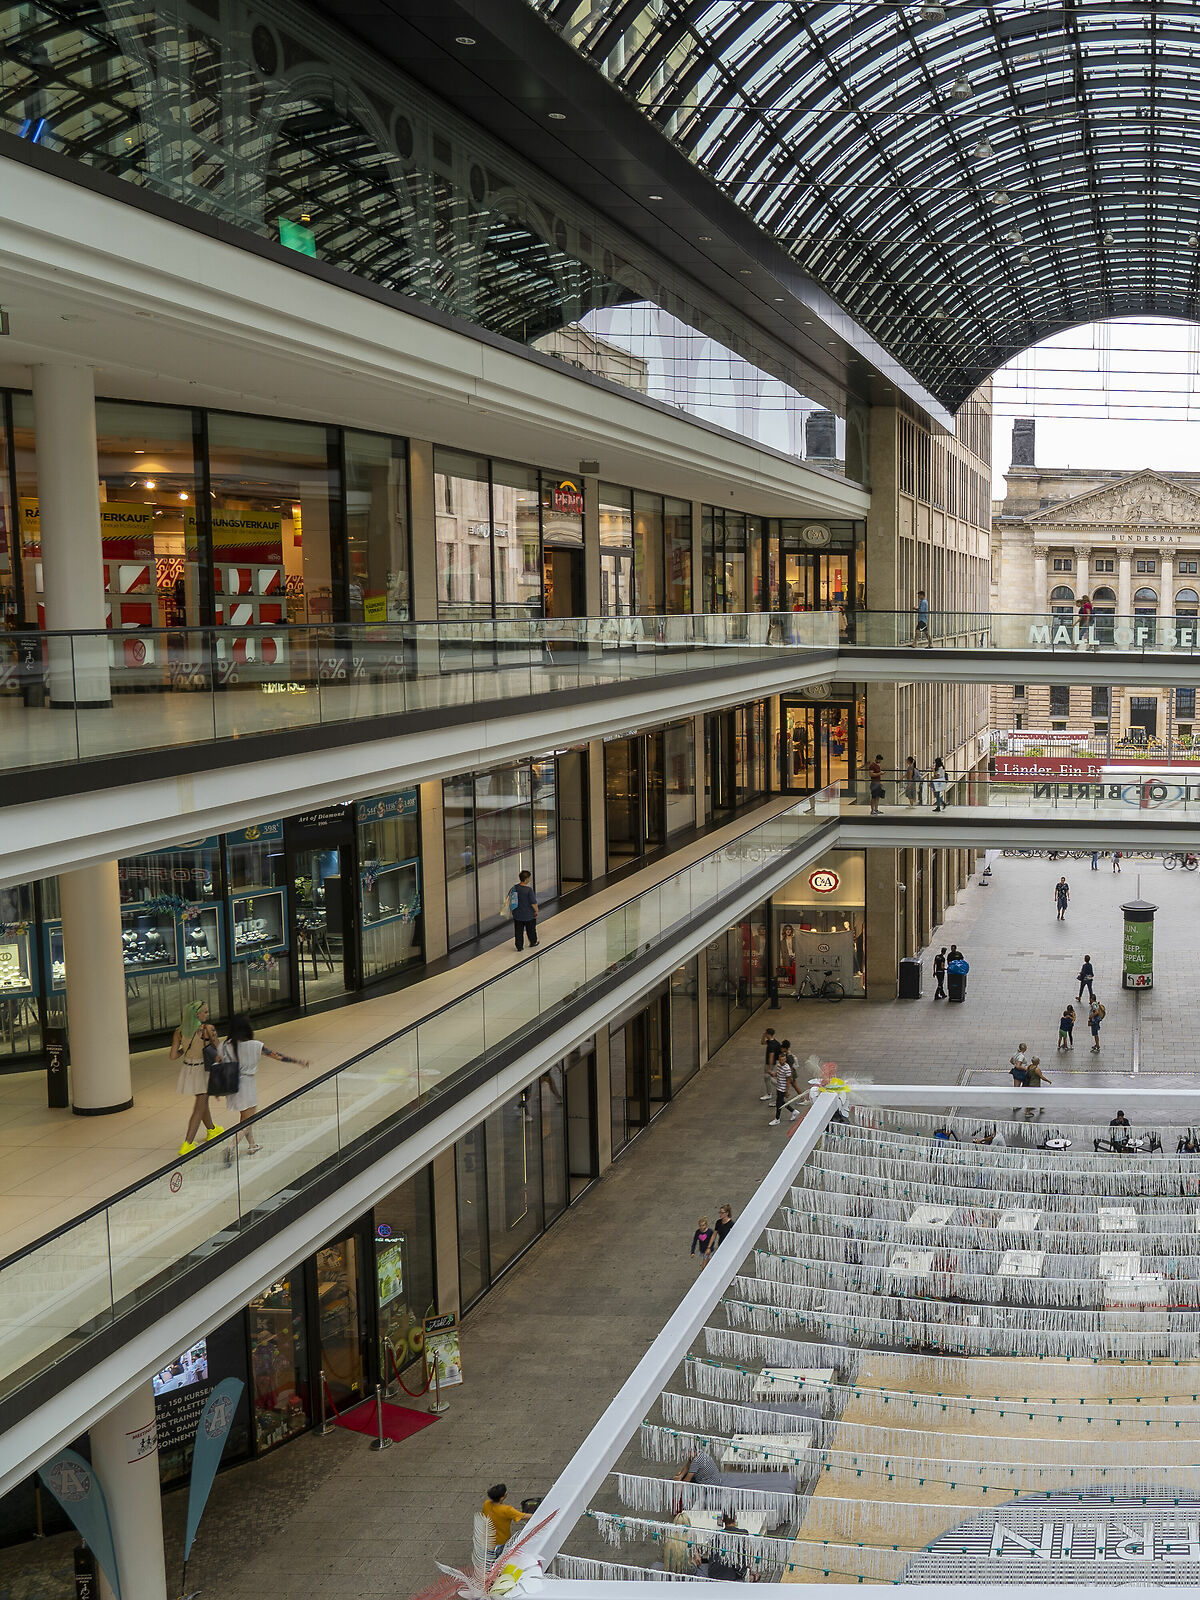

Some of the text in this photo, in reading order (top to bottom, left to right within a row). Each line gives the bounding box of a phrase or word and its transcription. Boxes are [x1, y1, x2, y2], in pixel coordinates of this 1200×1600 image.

[554, 488, 583, 515] RENO
[1111, 534, 1183, 543] BUNDESRAT
[1028, 624, 1100, 645] MALL
[1113, 626, 1149, 646] OF
[1004, 763, 1054, 777] Länder.
[1059, 765, 1083, 777] Ein
[318, 810, 345, 820] Diamond
[814, 876, 833, 888] C&A
[168, 1398, 182, 1407] 150
